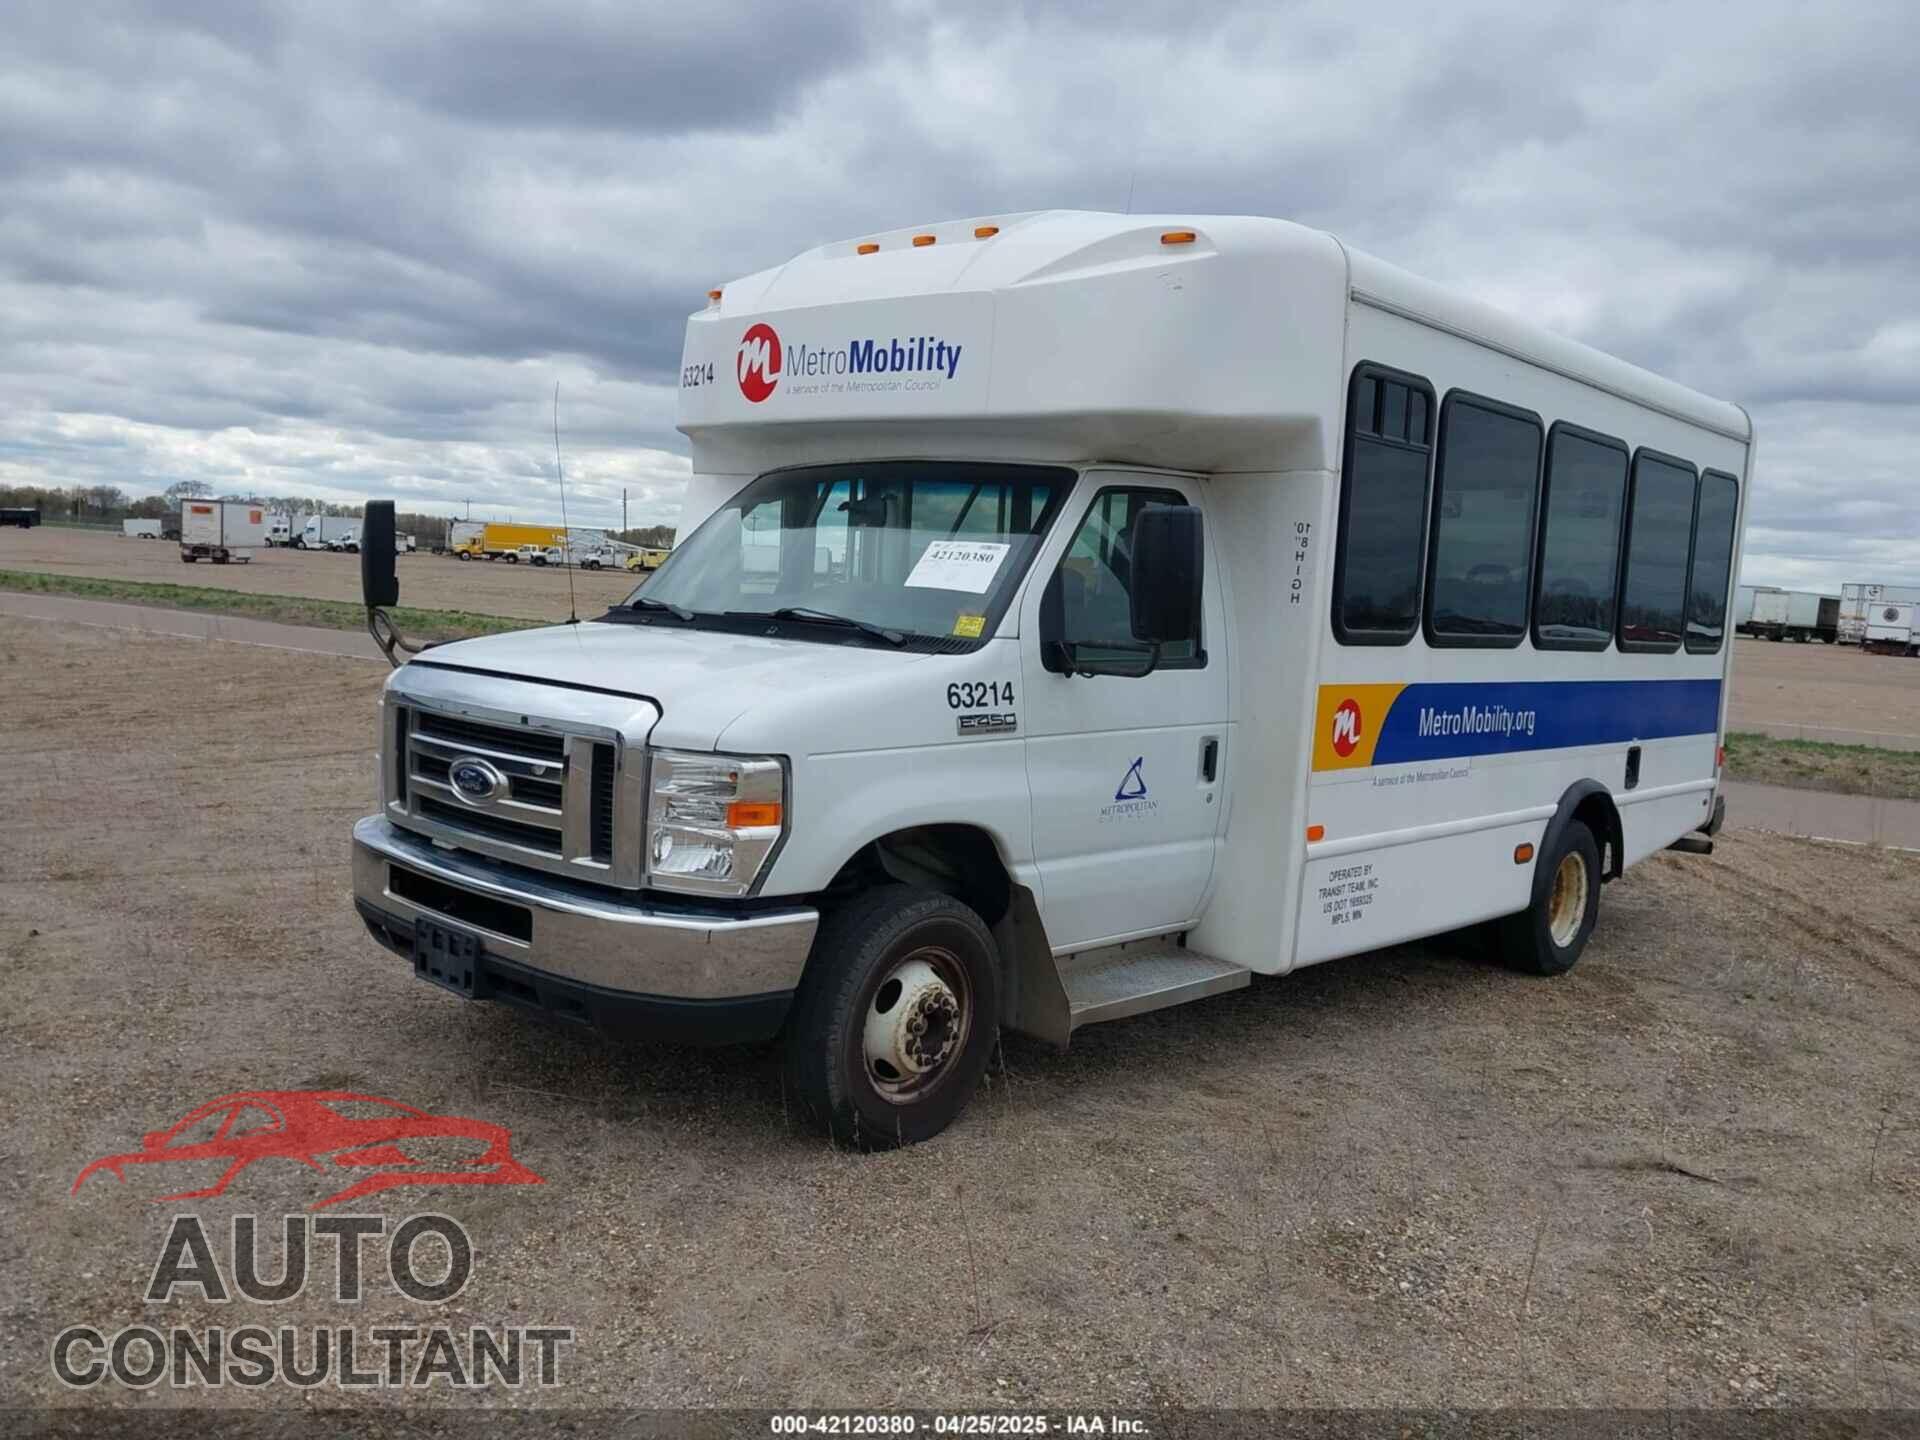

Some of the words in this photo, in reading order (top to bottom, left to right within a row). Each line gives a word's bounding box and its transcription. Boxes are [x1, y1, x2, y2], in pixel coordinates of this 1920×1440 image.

[786, 336, 962, 379] MetroMobility
[682, 362, 714, 388] 63214
[792, 383, 819, 394] service
[846, 380, 902, 392] Metropolitan
[905, 378, 942, 391] Council
[931, 550, 994, 563] 42120380
[947, 681, 1015, 709] 63214
[1419, 705, 1536, 737] MetroMobility.org
[1329, 866, 1362, 882] OPERATED
[1364, 864, 1374, 876] BY
[1319, 884, 1346, 899] TRANSIT
[1323, 902, 1333, 914] US
[1334, 898, 1347, 911] DOT
